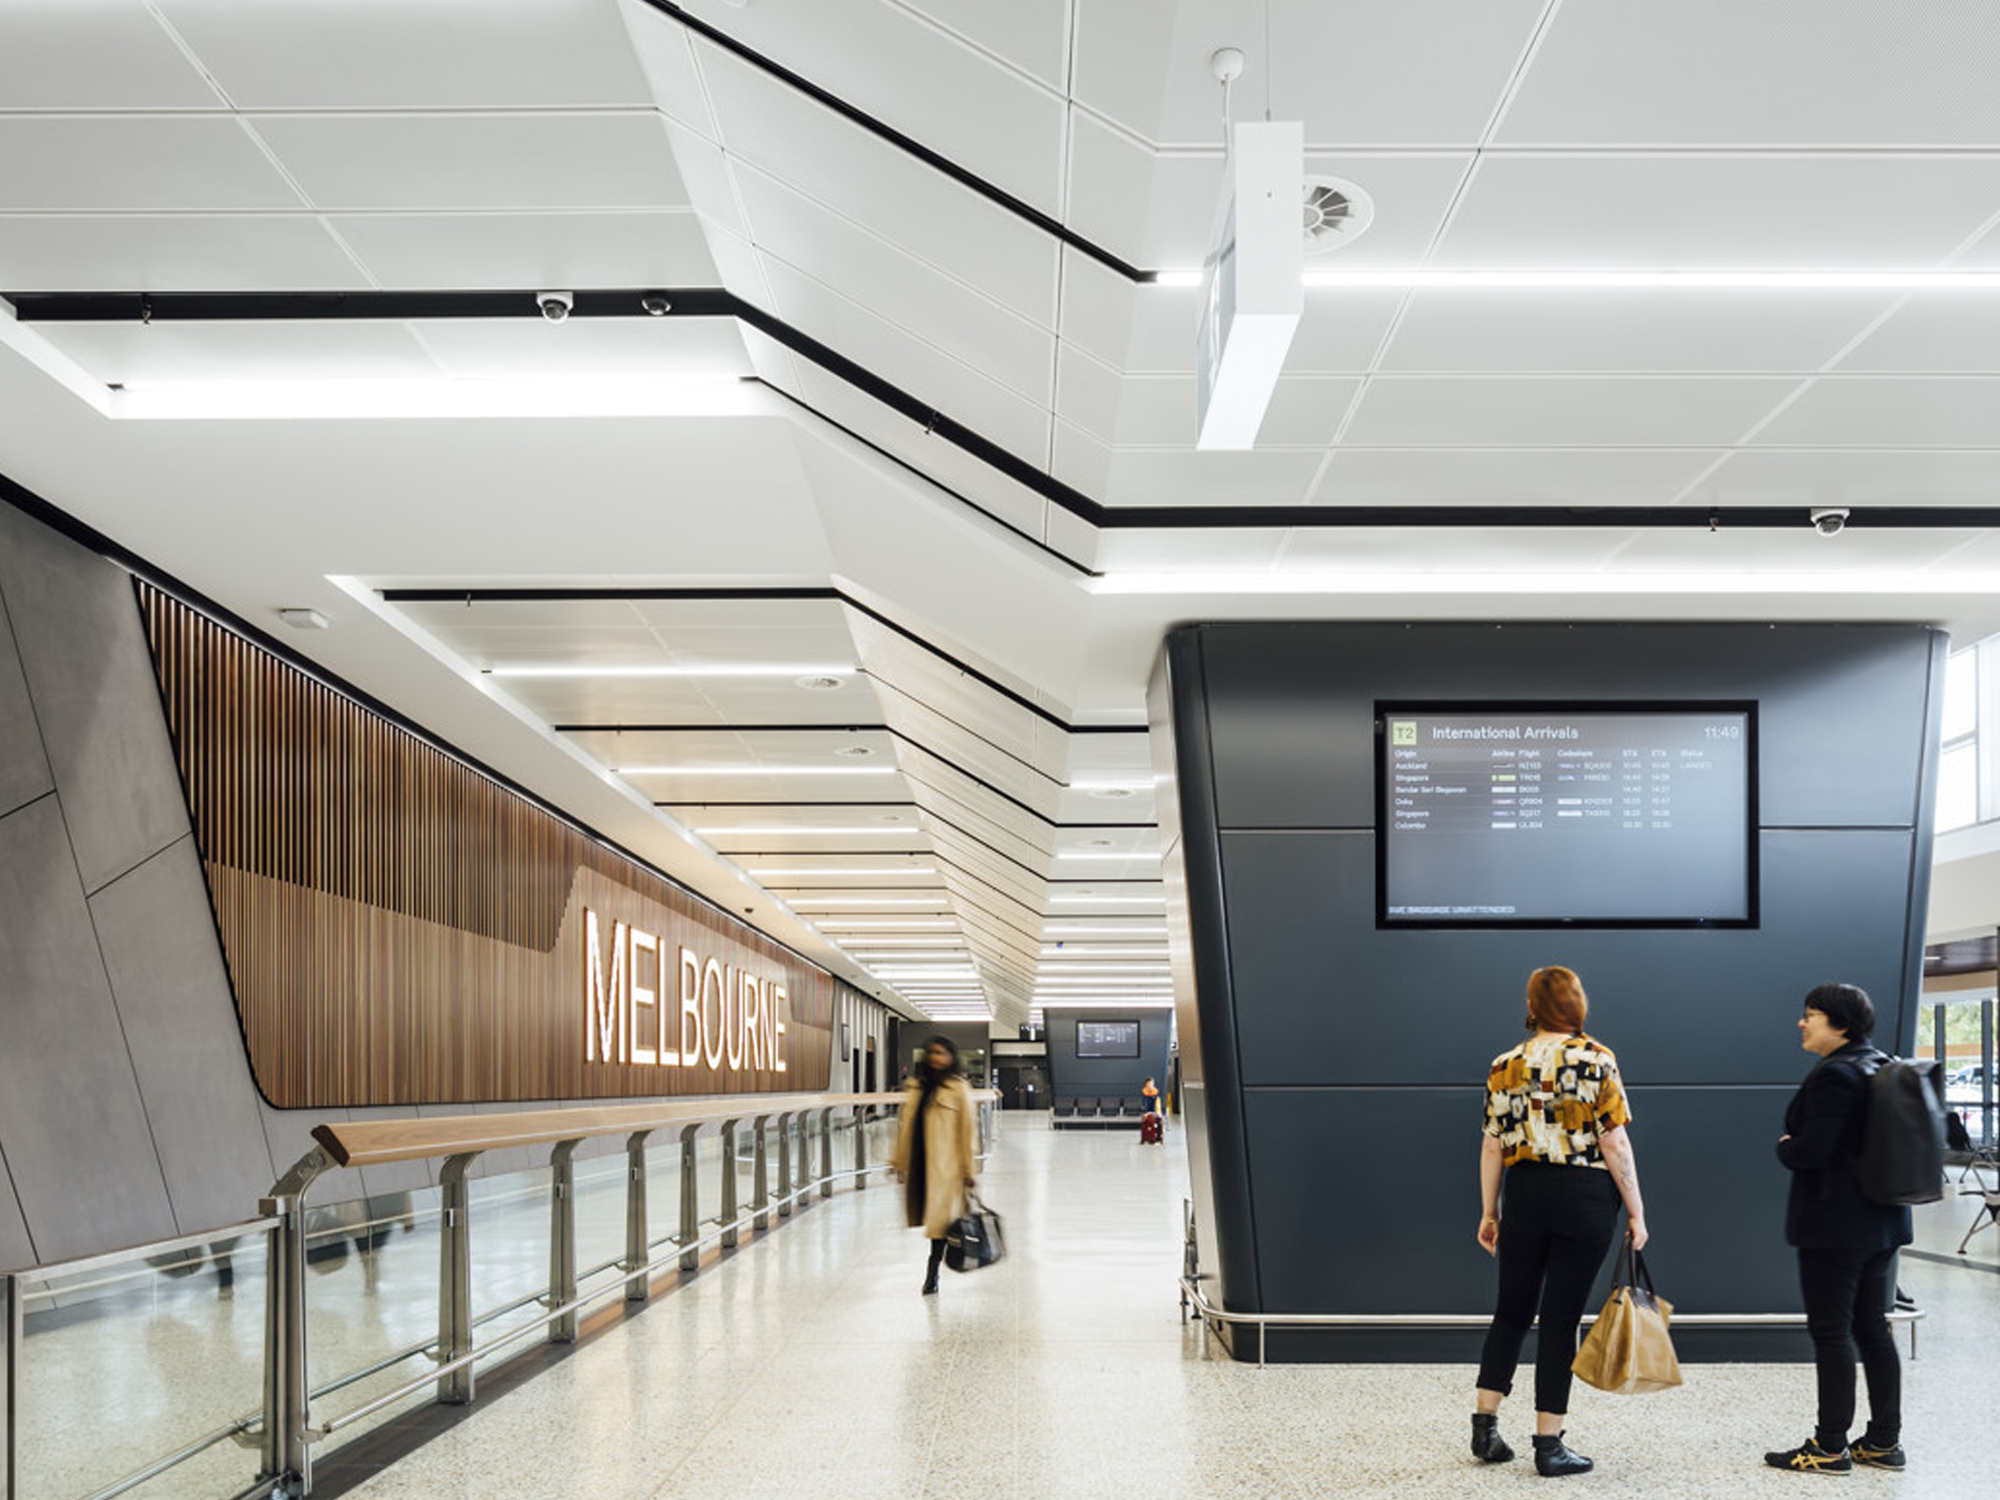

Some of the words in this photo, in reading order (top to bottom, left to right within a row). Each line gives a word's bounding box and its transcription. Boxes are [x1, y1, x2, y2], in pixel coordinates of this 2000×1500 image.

[1396, 727, 1414, 739] T2
[1432, 726, 1521, 739] International
[1524, 726, 1579, 739] Arrivals
[1395, 749, 1417, 759] Origin
[1518, 749, 1540, 758] Flight
[1395, 762, 1428, 770] Auckland
[1395, 774, 1429, 783] Singapore
[1395, 798, 1413, 806] Doha
[1395, 809, 1429, 818] Singapore
[1394, 821, 1426, 830] Colombo
[584, 908, 786, 1071] MELBOURNE
